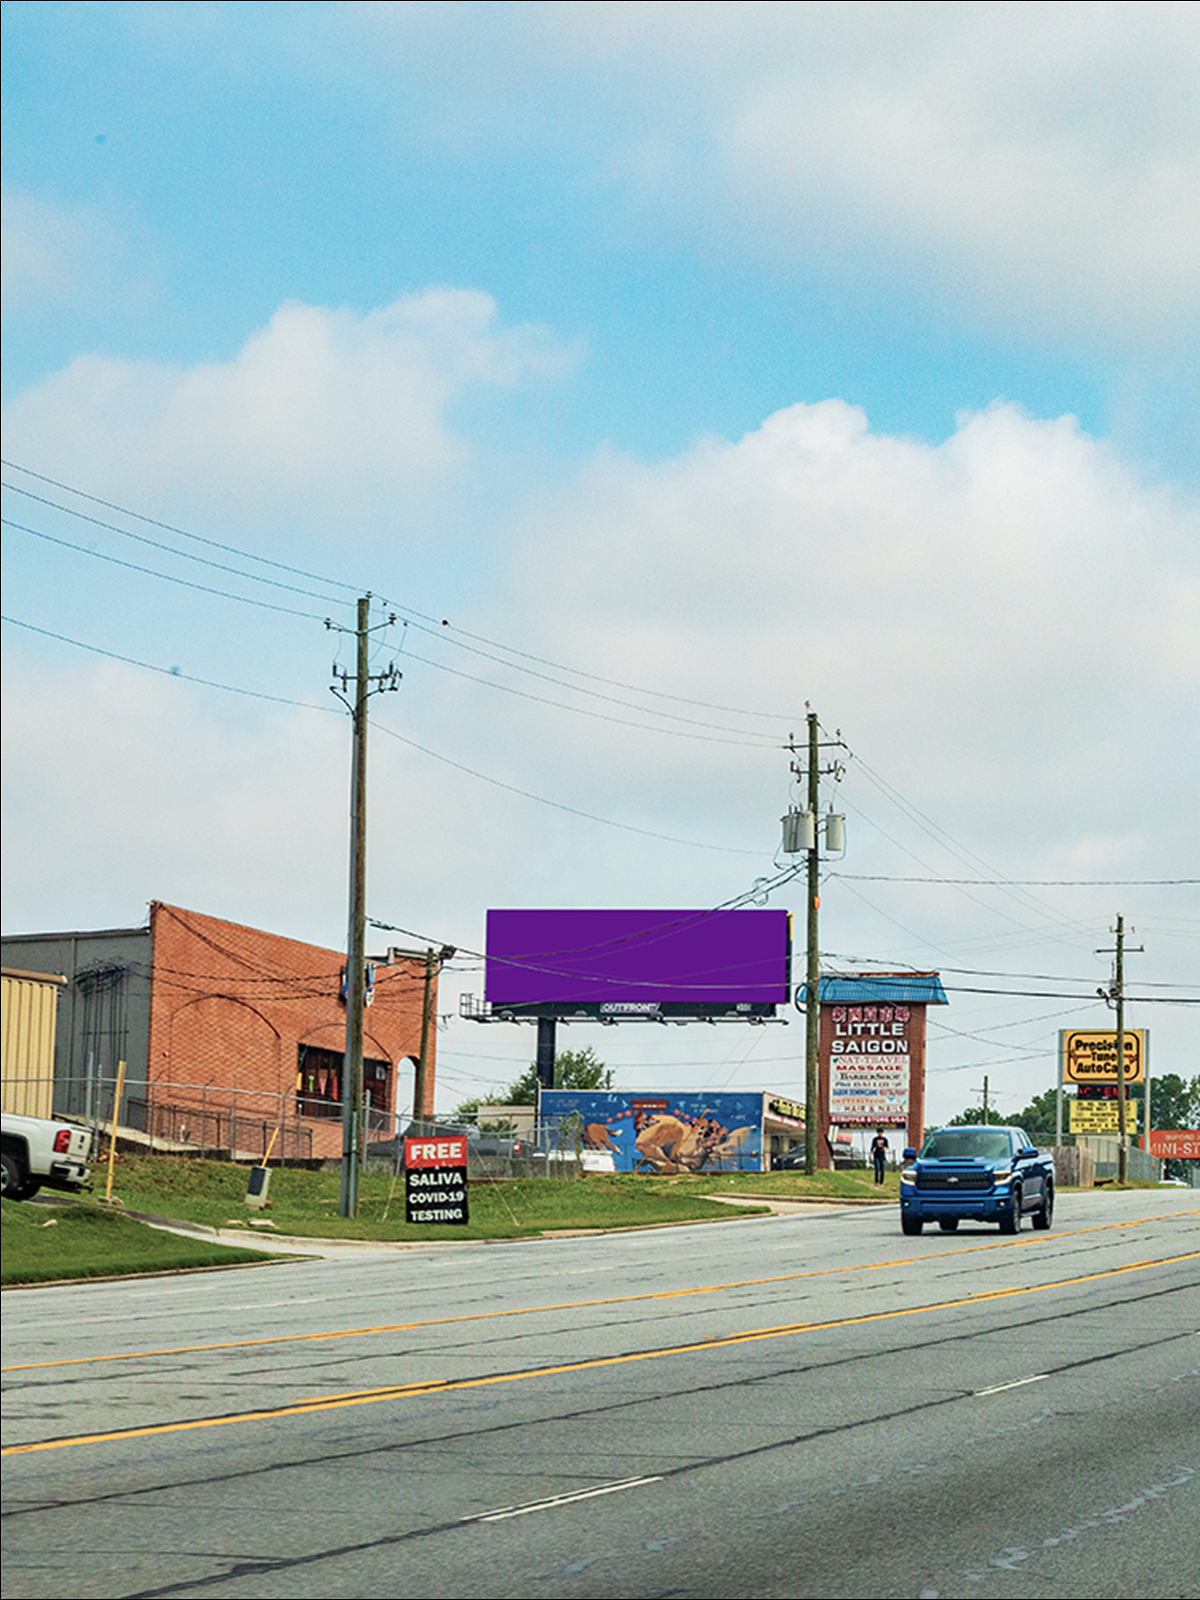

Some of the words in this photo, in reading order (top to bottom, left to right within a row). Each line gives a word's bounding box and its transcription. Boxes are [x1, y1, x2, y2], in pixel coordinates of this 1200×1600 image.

[836, 1023, 904, 1036] LITTLE
[831, 1040, 908, 1053] SAIGON
[411, 1143, 462, 1160] FREE
[409, 1172, 463, 1187] SALIVA
[409, 1191, 464, 1204] COVID-19
[410, 1208, 463, 1221] TESTING
